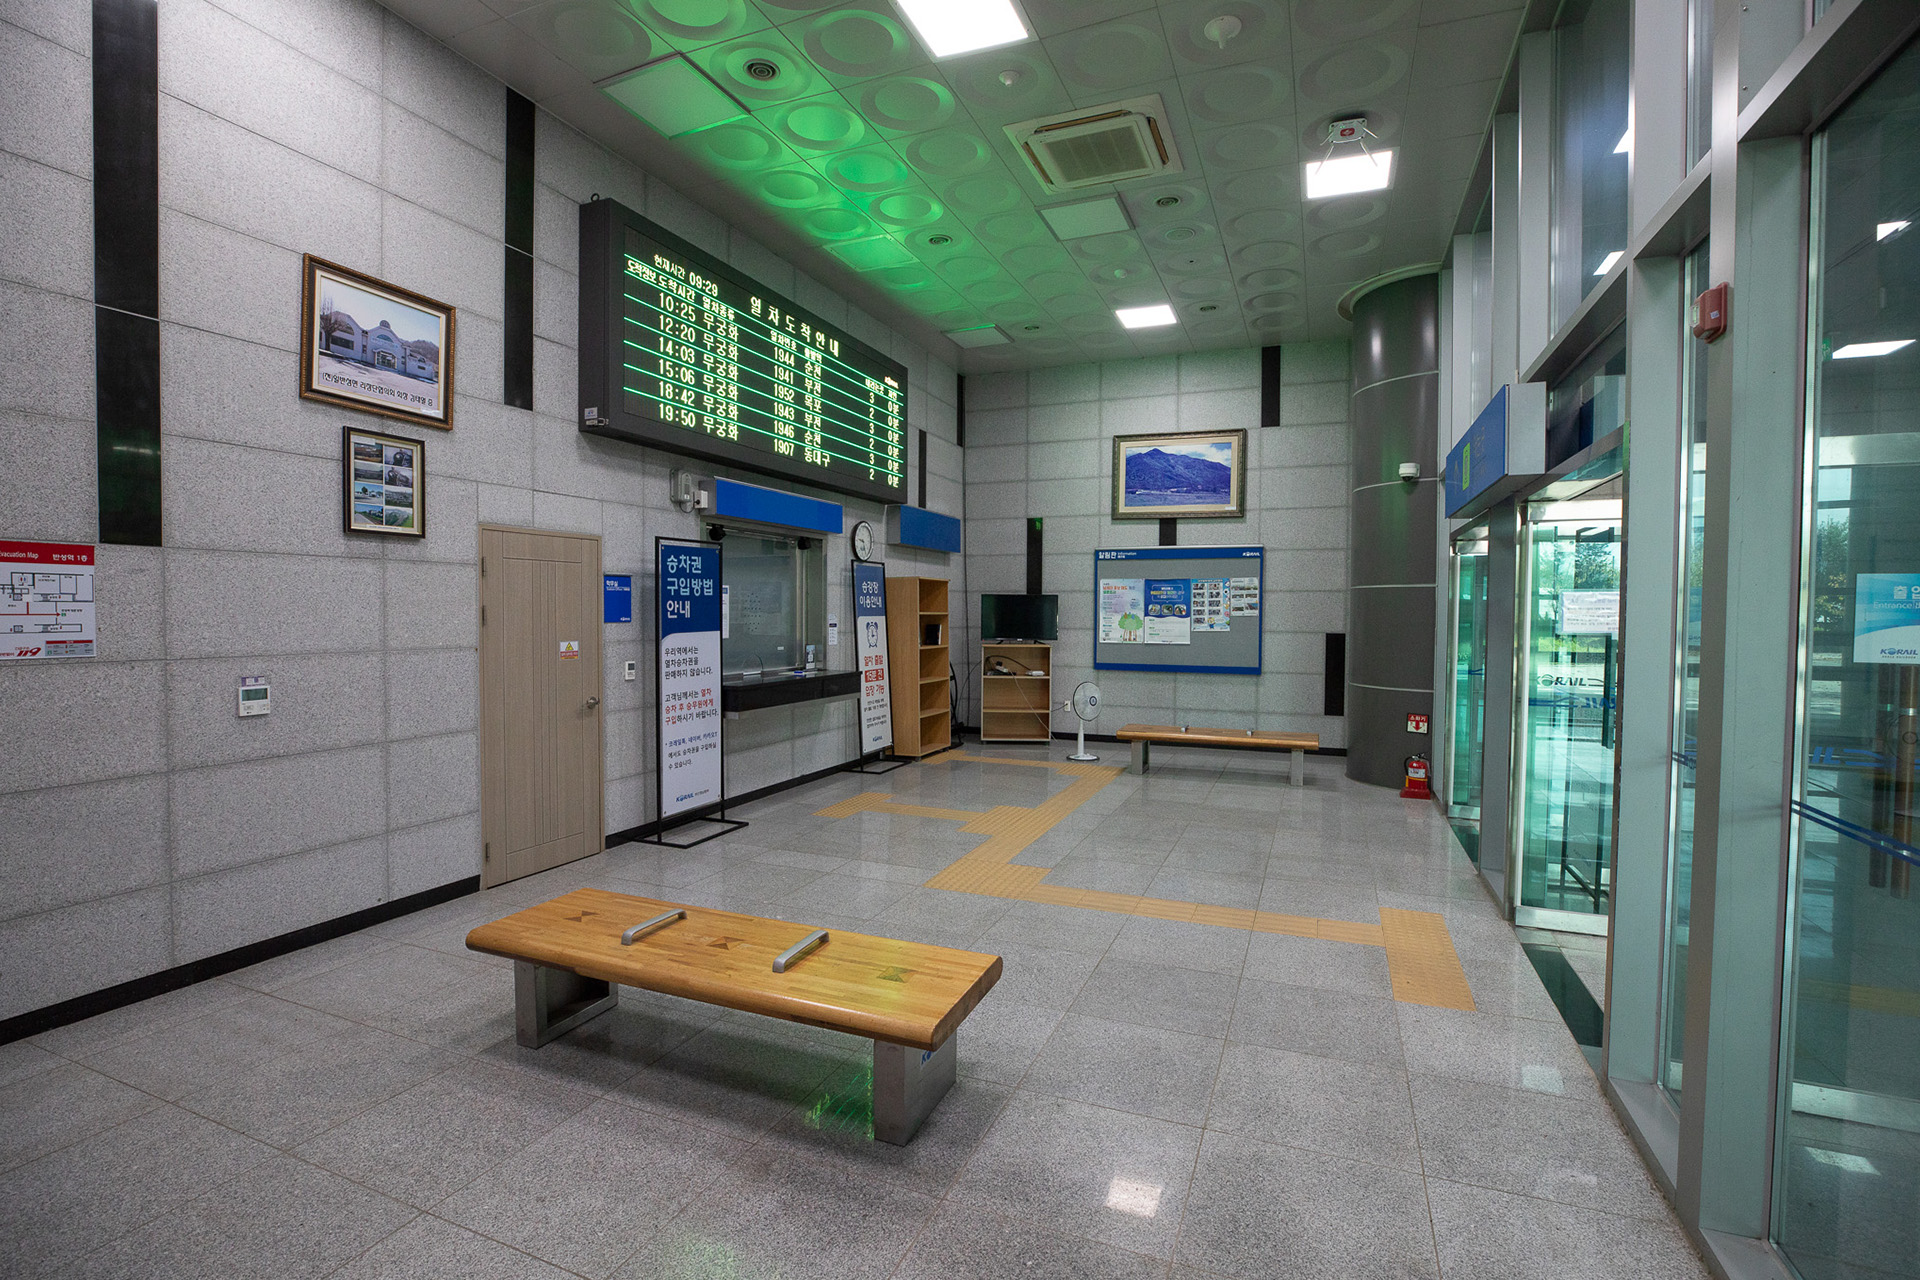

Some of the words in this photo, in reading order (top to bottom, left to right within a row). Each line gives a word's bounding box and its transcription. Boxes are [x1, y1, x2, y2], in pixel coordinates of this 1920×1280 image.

[654, 254, 686, 280] 현재시간
[689, 271, 718, 297] 09:29
[658, 275, 696, 303] 도착시간
[659, 292, 696, 322] 10:25
[702, 312, 739, 342] 무궁화
[773, 346, 795, 367] 1944
[804, 361, 821, 380] 순천
[869, 392, 875, 404] 3
[659, 314, 696, 343] 12:20
[702, 333, 739, 362] 무궁화
[773, 365, 794, 385] 1941
[804, 377, 821, 397] 부전
[869, 407, 875, 419] 2
[659, 336, 695, 364] 14:03
[702, 353, 739, 382] 무궁화
[773, 383, 795, 403] 1952
[804, 395, 821, 413] 목포
[869, 422, 875, 434] 3
[659, 358, 695, 386] 15:06
[702, 374, 739, 402] 무궁화
[773, 401, 795, 421] 1943
[804, 412, 821, 431] 부전
[869, 437, 875, 450] 2
[659, 380, 695, 407] 18:42
[702, 395, 739, 421] 무궁화
[773, 420, 795, 439] 1946
[804, 430, 821, 448] 순천
[869, 453, 875, 465] 3
[659, 403, 696, 428] 19:50
[702, 415, 739, 441] 무궁화
[773, 438, 795, 456] 1907
[804, 447, 831, 468] 동대구
[869, 468, 875, 480] 2
[27, 551, 39, 560] Map
[667, 554, 702, 574] 승차권
[667, 577, 713, 597] 구입방법
[861, 581, 879, 594] 승강장
[666, 600, 691, 618] 안내
[860, 595, 882, 608] 이용안내
[1873, 601, 1912, 609] Entrance
[17, 647, 42, 657] 119
[665, 646, 699, 657] 우리역에서는
[1880, 647, 1918, 656] KORAIL
[665, 656, 699, 669] 열차승차권을
[665, 669, 688, 680] 판매하지
[690, 666, 713, 677] 않습니다.
[665, 690, 699, 702] 고객님께서는
[701, 688, 712, 697] 열차
[865, 685, 874, 697] 입장
[665, 704, 677, 715] 승차
[679, 703, 684, 711] 후
[686, 698, 714, 711] 승무원에게
[665, 712, 694, 726] 구입하시기
[695, 708, 719, 719] 바랍니다.
